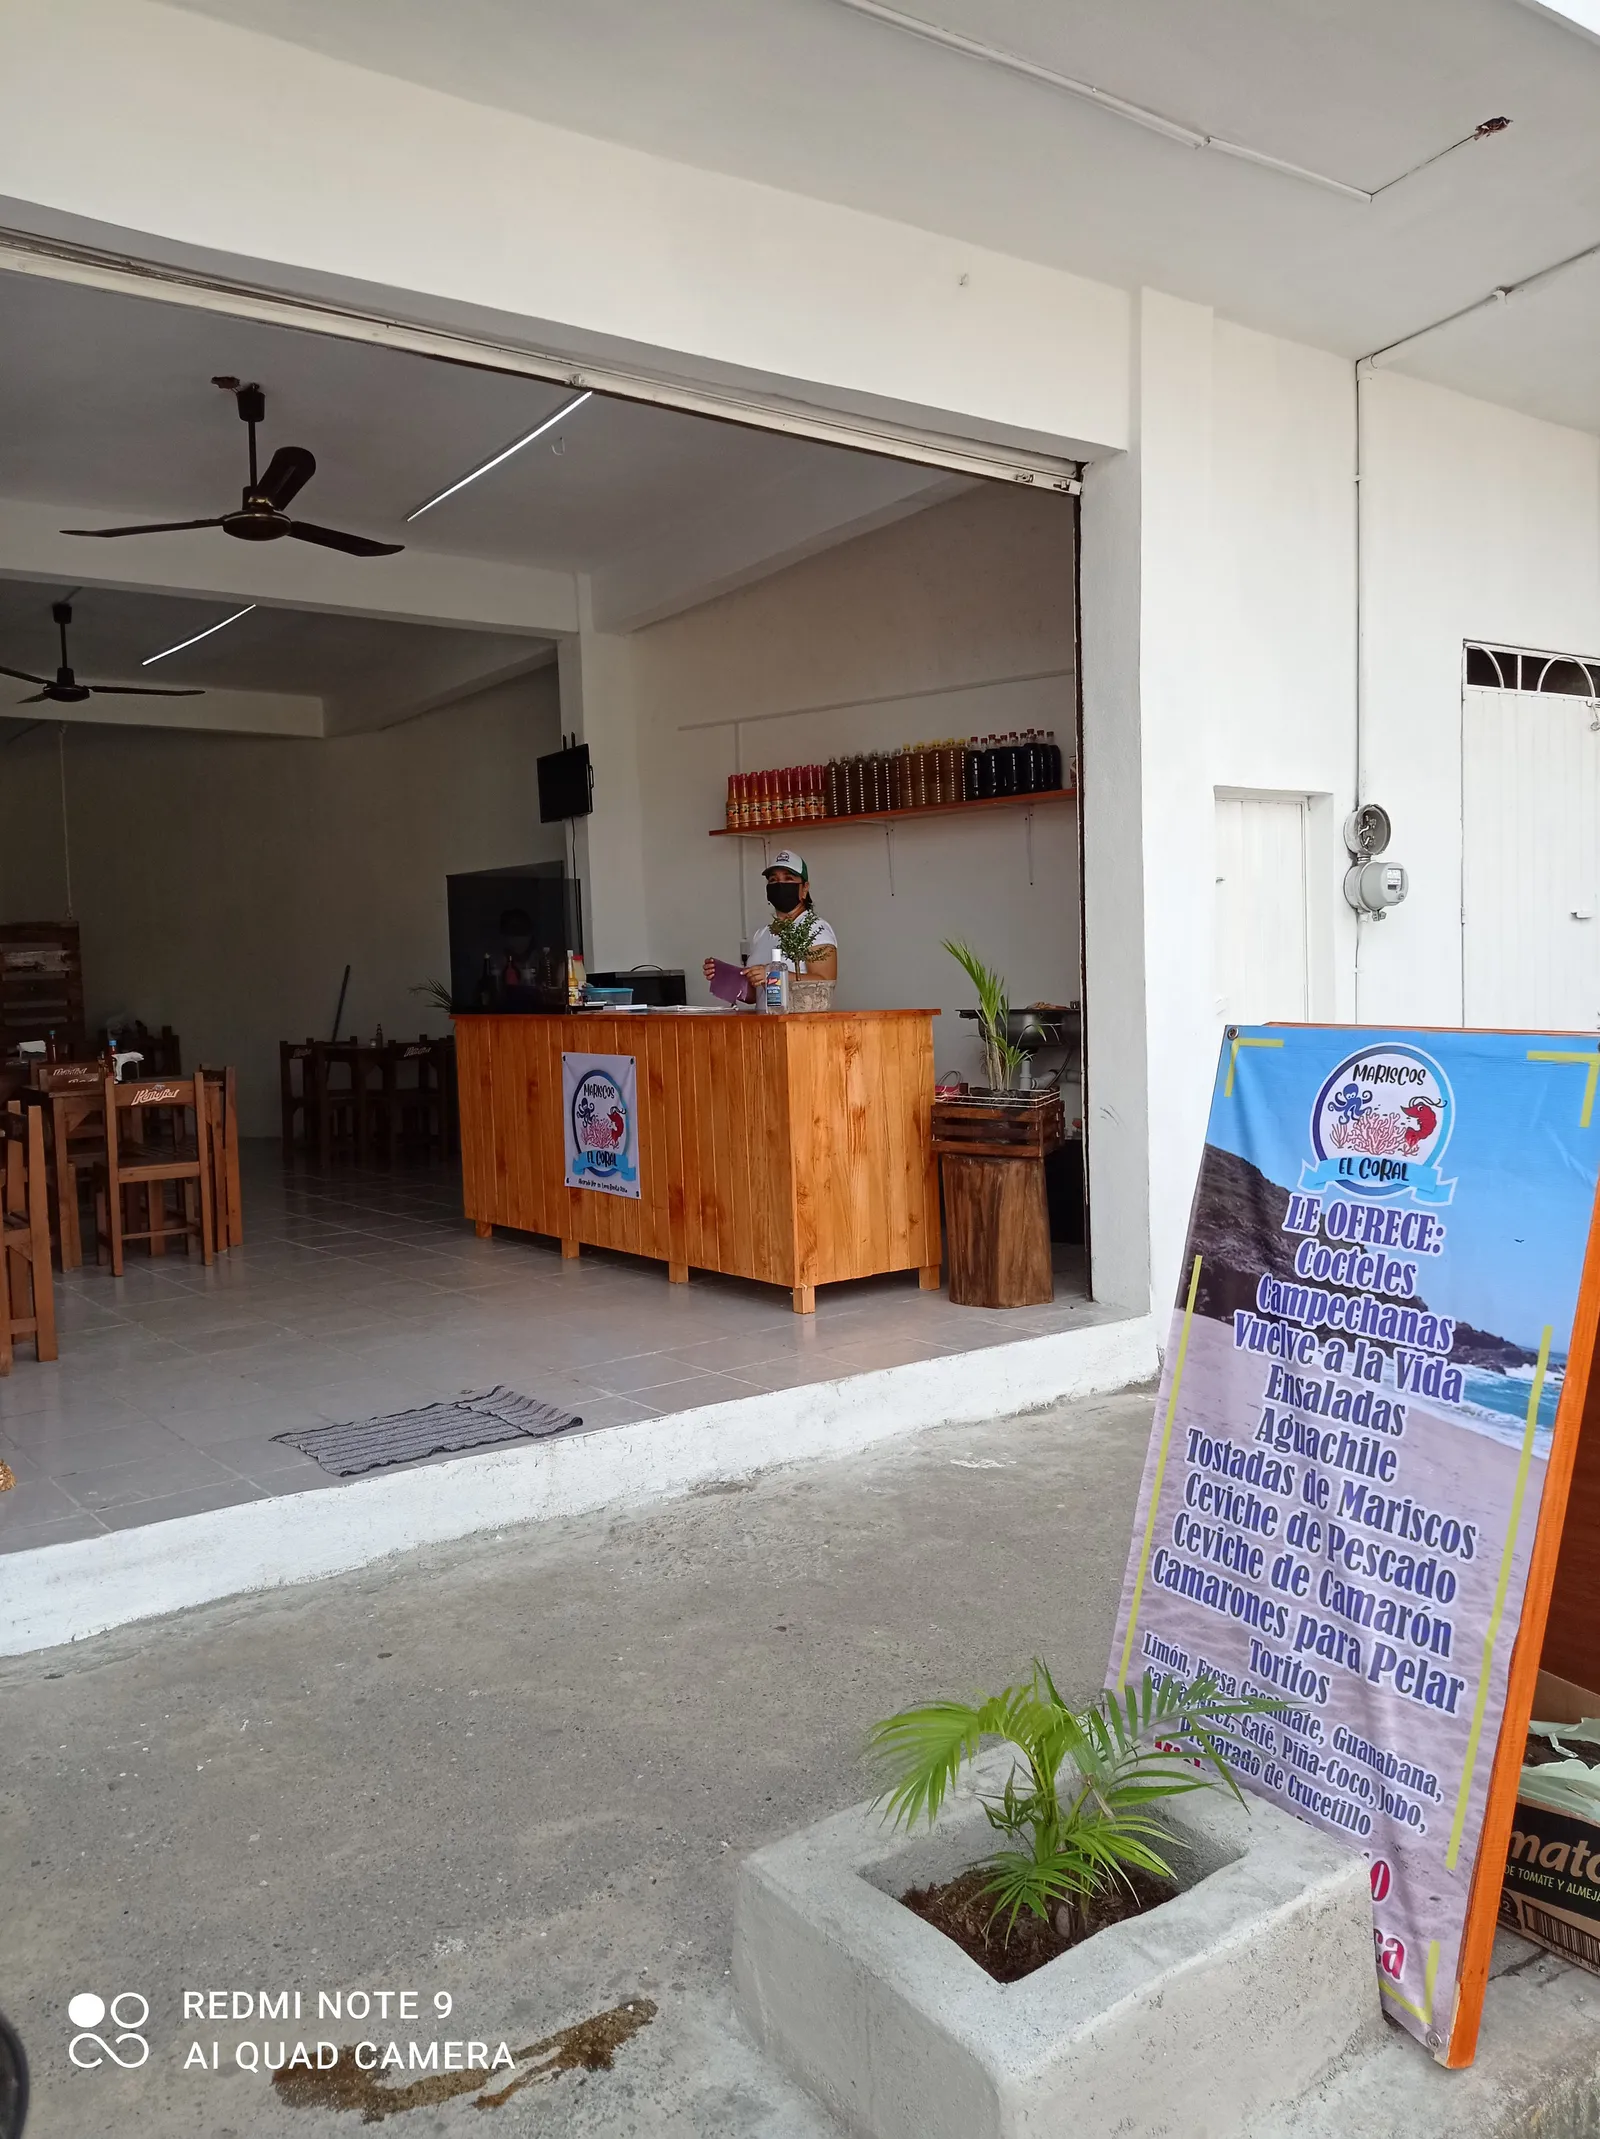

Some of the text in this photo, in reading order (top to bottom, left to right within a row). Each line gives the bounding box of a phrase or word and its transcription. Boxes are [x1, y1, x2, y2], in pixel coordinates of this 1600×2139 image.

[583, 1083, 615, 1100] MARISCOS
[1352, 1064, 1426, 1086] MARISCOS
[586, 1150, 617, 1168] EL CORAL
[1338, 1157, 1409, 1182] EL CORAL
[1285, 1196, 1444, 1253] LE OFRECE:
[1297, 1242, 1416, 1296] Cocteles
[1259, 1275, 1453, 1350] Campechanas
[1235, 1313, 1461, 1403] Vuelve a la Vida
[1265, 1365, 1405, 1436] Ensaladas
[1255, 1407, 1396, 1482] Aguachile
[1186, 1429, 1476, 1559] Tostadas de Mariscos
[1185, 1473, 1456, 1604] Ceviche de Pescado
[1174, 1513, 1451, 1658] Ceviche de Camarón
[1152, 1549, 1464, 1714] Camarones para Pelar
[1250, 1639, 1330, 1704] Toritos
[1143, 1633, 1190, 1676] Limón,
[1333, 1727, 1442, 1802] Guanabana,
[1241, 1715, 1276, 1755] Café,
[1376, 1785, 1425, 1832] Jobo,
[1264, 1759, 1283, 1790] de
[1288, 1776, 1371, 1836] Crucetillo
[1518, 1867, 1553, 1888] TOMATE
[1557, 1879, 1565, 1891] Y
